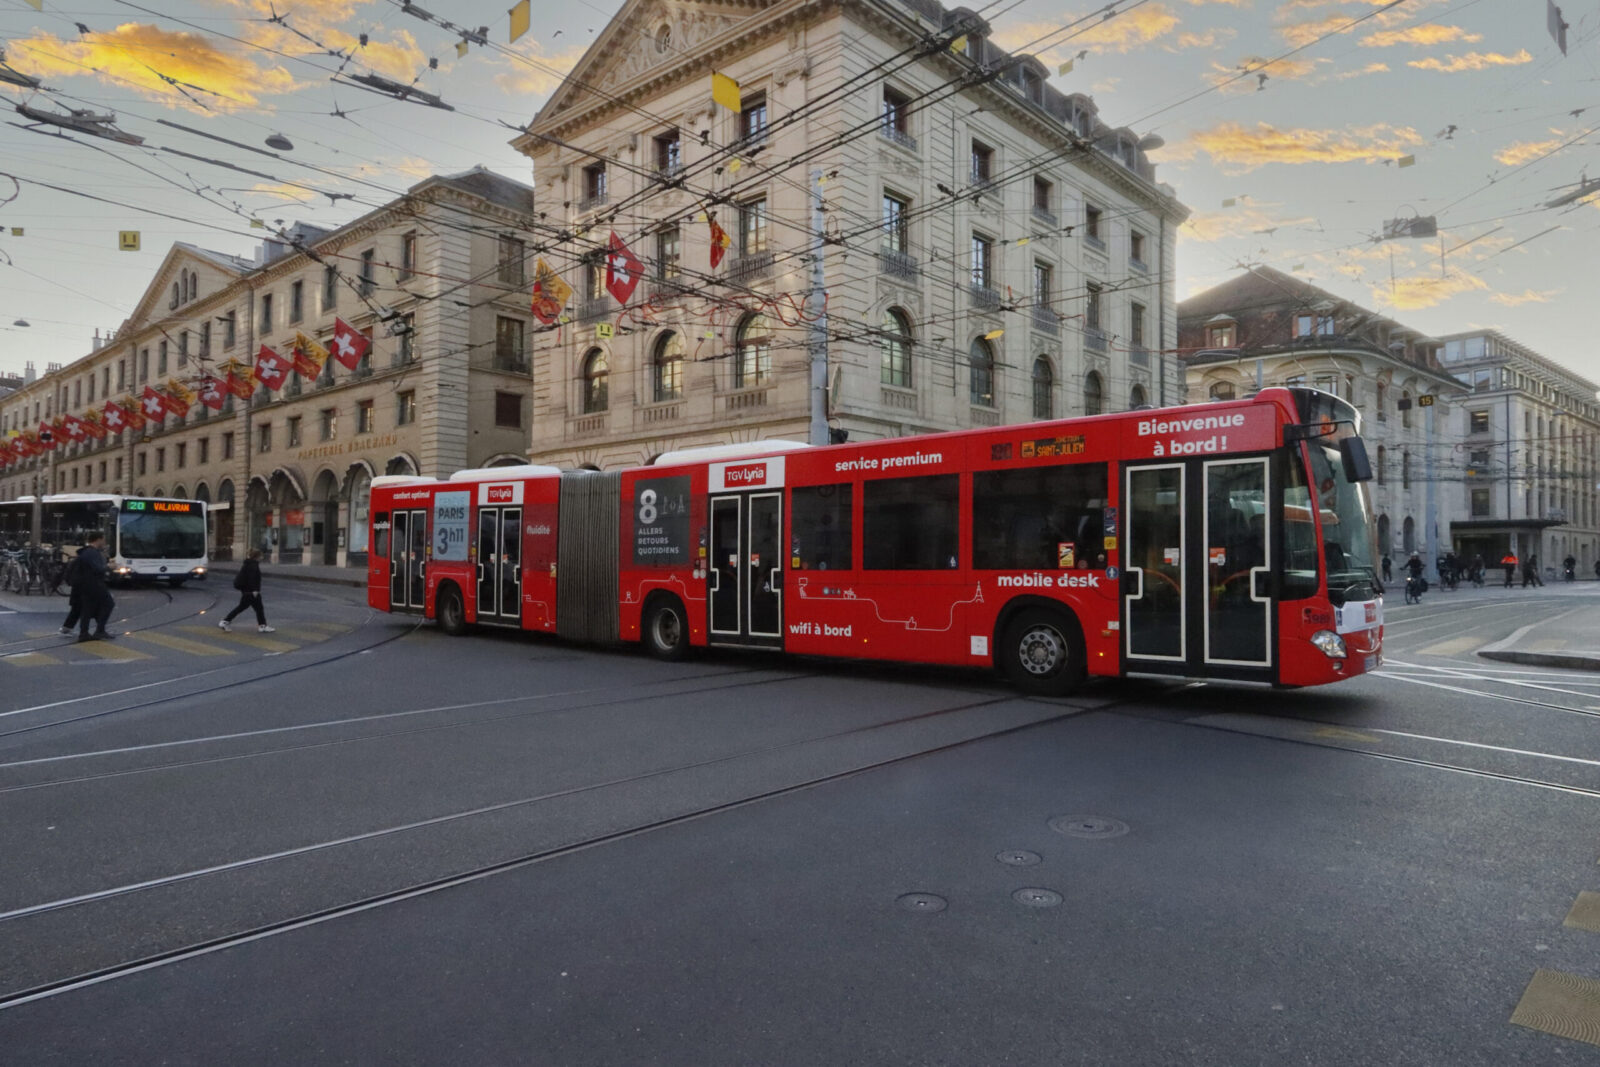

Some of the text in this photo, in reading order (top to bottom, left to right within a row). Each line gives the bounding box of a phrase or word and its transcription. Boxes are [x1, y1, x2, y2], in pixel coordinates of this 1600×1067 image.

[1138, 414, 1245, 436] Bienvenue
[1037, 442, 1085, 457] SAINT-JULIEN
[1153, 441, 1165, 456] à
[1170, 436, 1217, 455] bord
[835, 451, 942, 471] service premium
[393, 491, 411, 499] confort
[411, 490, 430, 500] optimal
[129, 502, 145, 510] 20
[154, 502, 190, 511] VALAVRAN
[639, 489, 657, 524] 8
[438, 507, 464, 519] PARIS
[526, 524, 551, 535] fluidité
[638, 527, 663, 535] ALLERS
[638, 537, 669, 545] RETOURS
[638, 546, 680, 556] QUOTIDIENS
[997, 572, 1099, 588] mobile desk
[790, 621, 852, 637] wifi à bord
